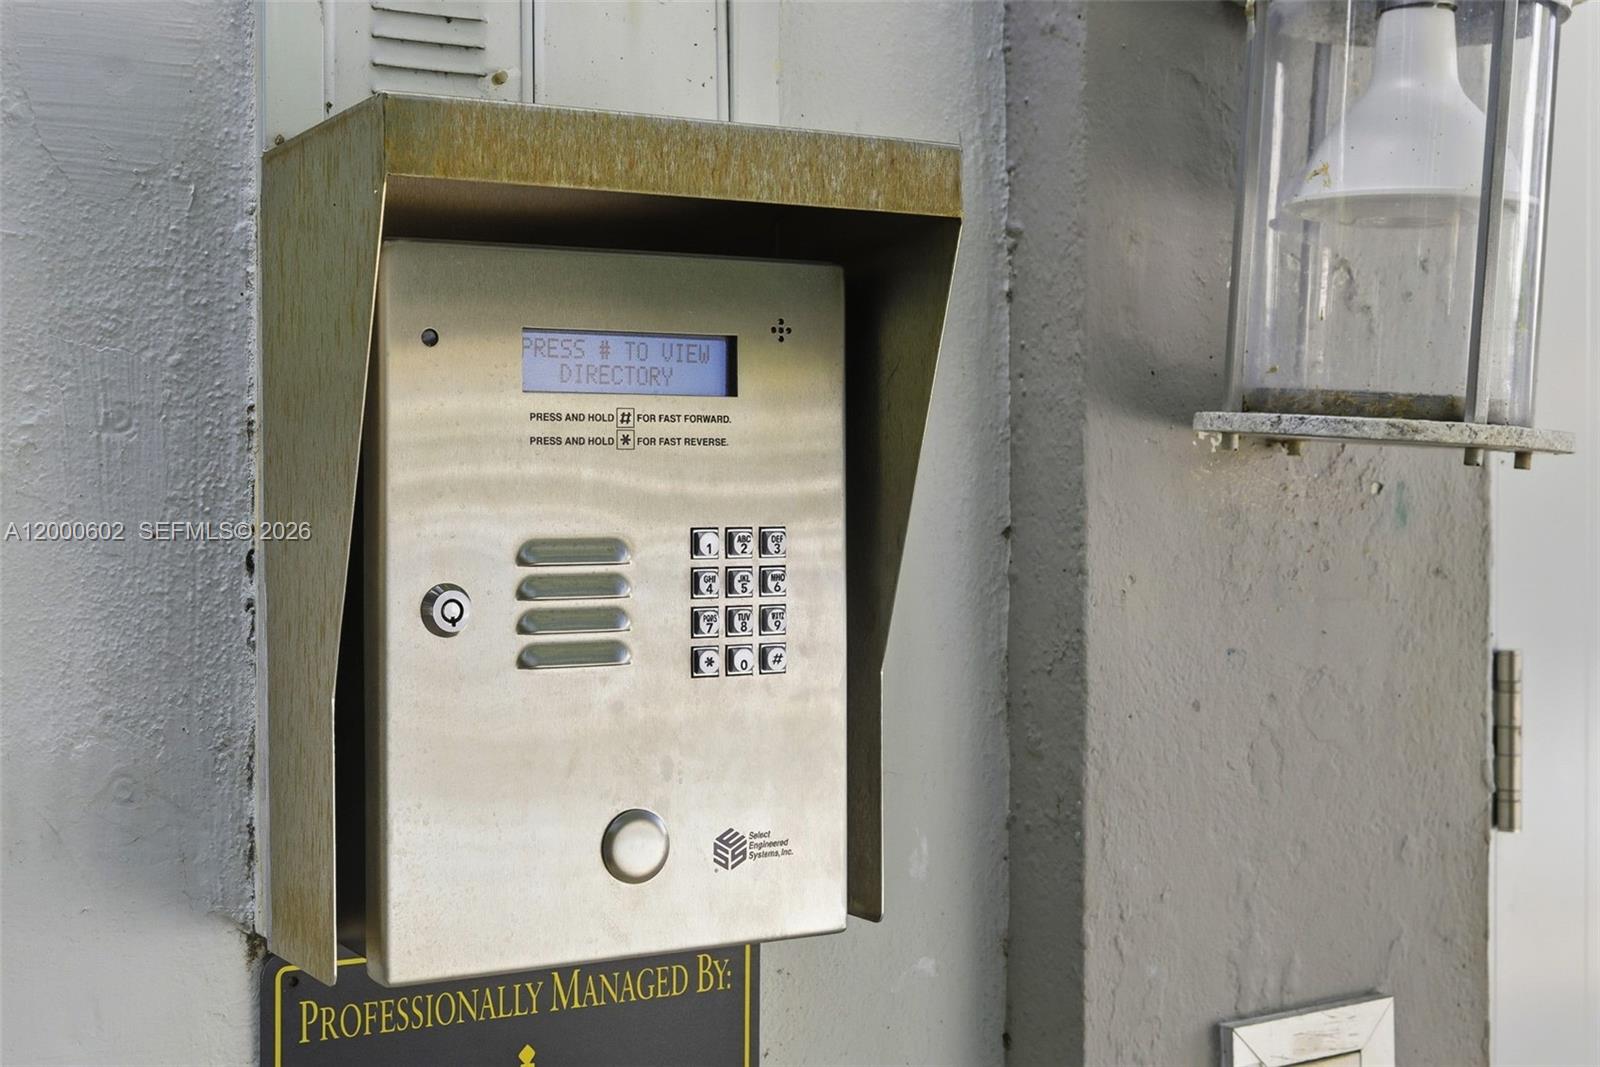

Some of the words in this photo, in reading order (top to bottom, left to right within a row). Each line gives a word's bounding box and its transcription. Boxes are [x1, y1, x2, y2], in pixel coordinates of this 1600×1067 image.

[522, 337, 586, 359] PRESS
[599, 340, 611, 360] #
[624, 341, 649, 361] TO
[662, 343, 710, 364] VIEW
[559, 363, 674, 386] DIRECTORY
[529, 412, 563, 422] PRESS
[564, 412, 586, 422] AND
[587, 413, 615, 422] HOLD
[637, 413, 657, 423] FOR
[658, 413, 682, 423] FAST
[684, 414, 732, 424] FORWARD.
[529, 436, 563, 446] PRESS
[564, 436, 586, 446] AND
[587, 436, 615, 446] HOLD
[637, 437, 657, 446] FOR
[658, 437, 682, 446] FAST
[684, 437, 729, 447] REVERSE.
[737, 535, 751, 543] ABC
[771, 535, 783, 543] DEF
[706, 543, 712, 554] 1
[740, 544, 748, 554] 2
[774, 543, 781, 554] 3
[703, 575, 716, 583] GHI
[738, 575, 750, 583] JKL
[706, 584, 713, 594] 4
[741, 583, 748, 594] 5
[774, 582, 781, 592] 6
[738, 613, 750, 621] TUV
[706, 623, 713, 633] 7
[740, 622, 747, 632] 8
[774, 620, 781, 631] 9
[740, 659, 748, 670] 0
[749, 830, 771, 840] Select
[749, 838, 789, 850] Engineered
[749, 850, 780, 861] Systems,
[781, 848, 794, 856] Inc.
[298, 980, 544, 1044] PROFESSIONALLY
[549, 962, 689, 1013] MANAGED
